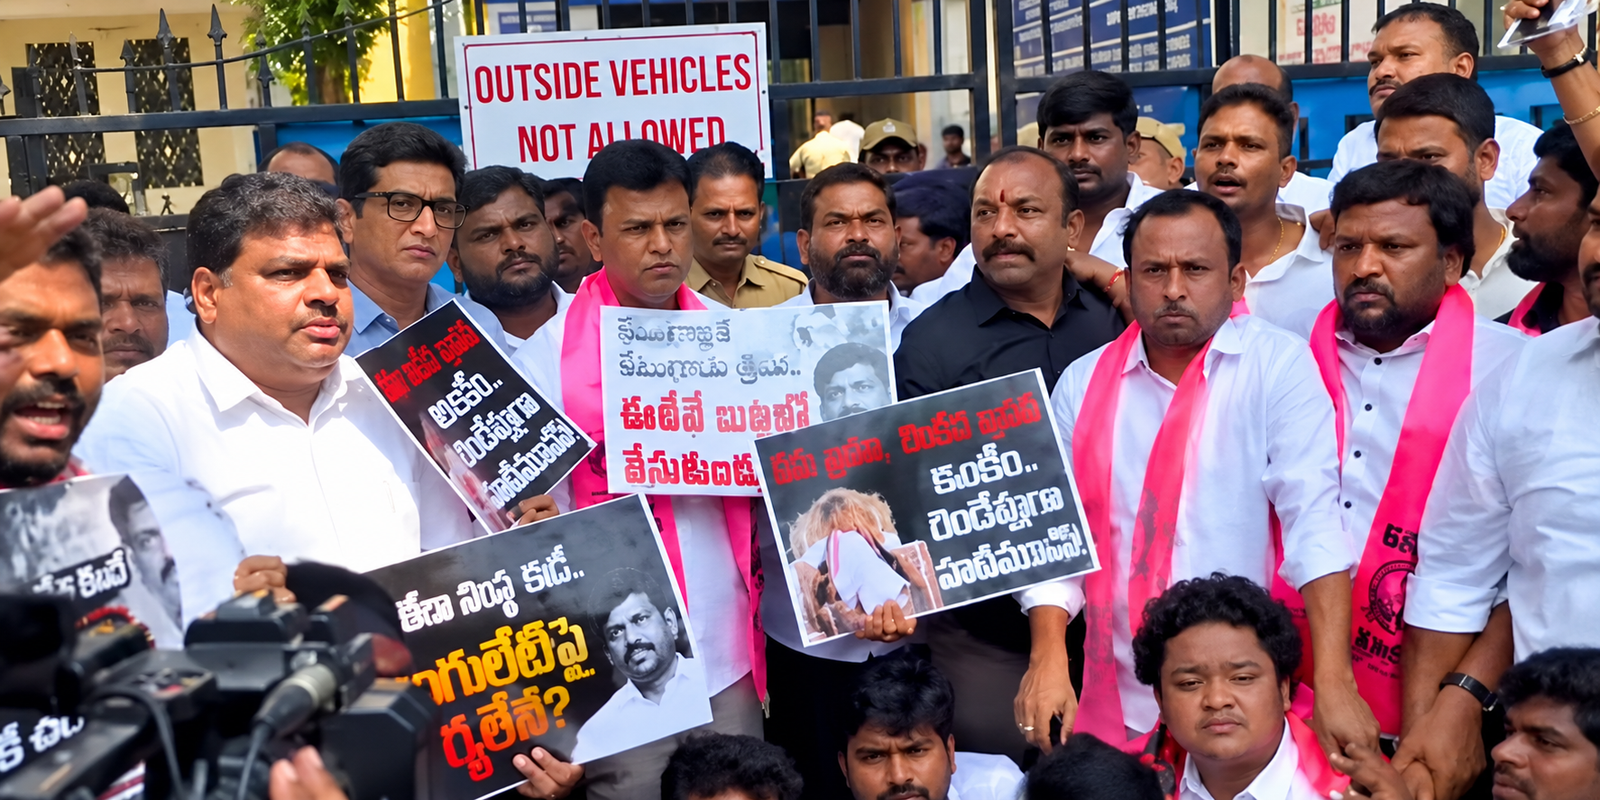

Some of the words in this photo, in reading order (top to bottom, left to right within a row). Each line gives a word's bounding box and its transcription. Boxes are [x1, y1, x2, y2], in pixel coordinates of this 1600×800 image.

[475, 61, 602, 104] OUTSIDE
[610, 53, 751, 97] VEHICLES
[518, 124, 576, 163] NOT
